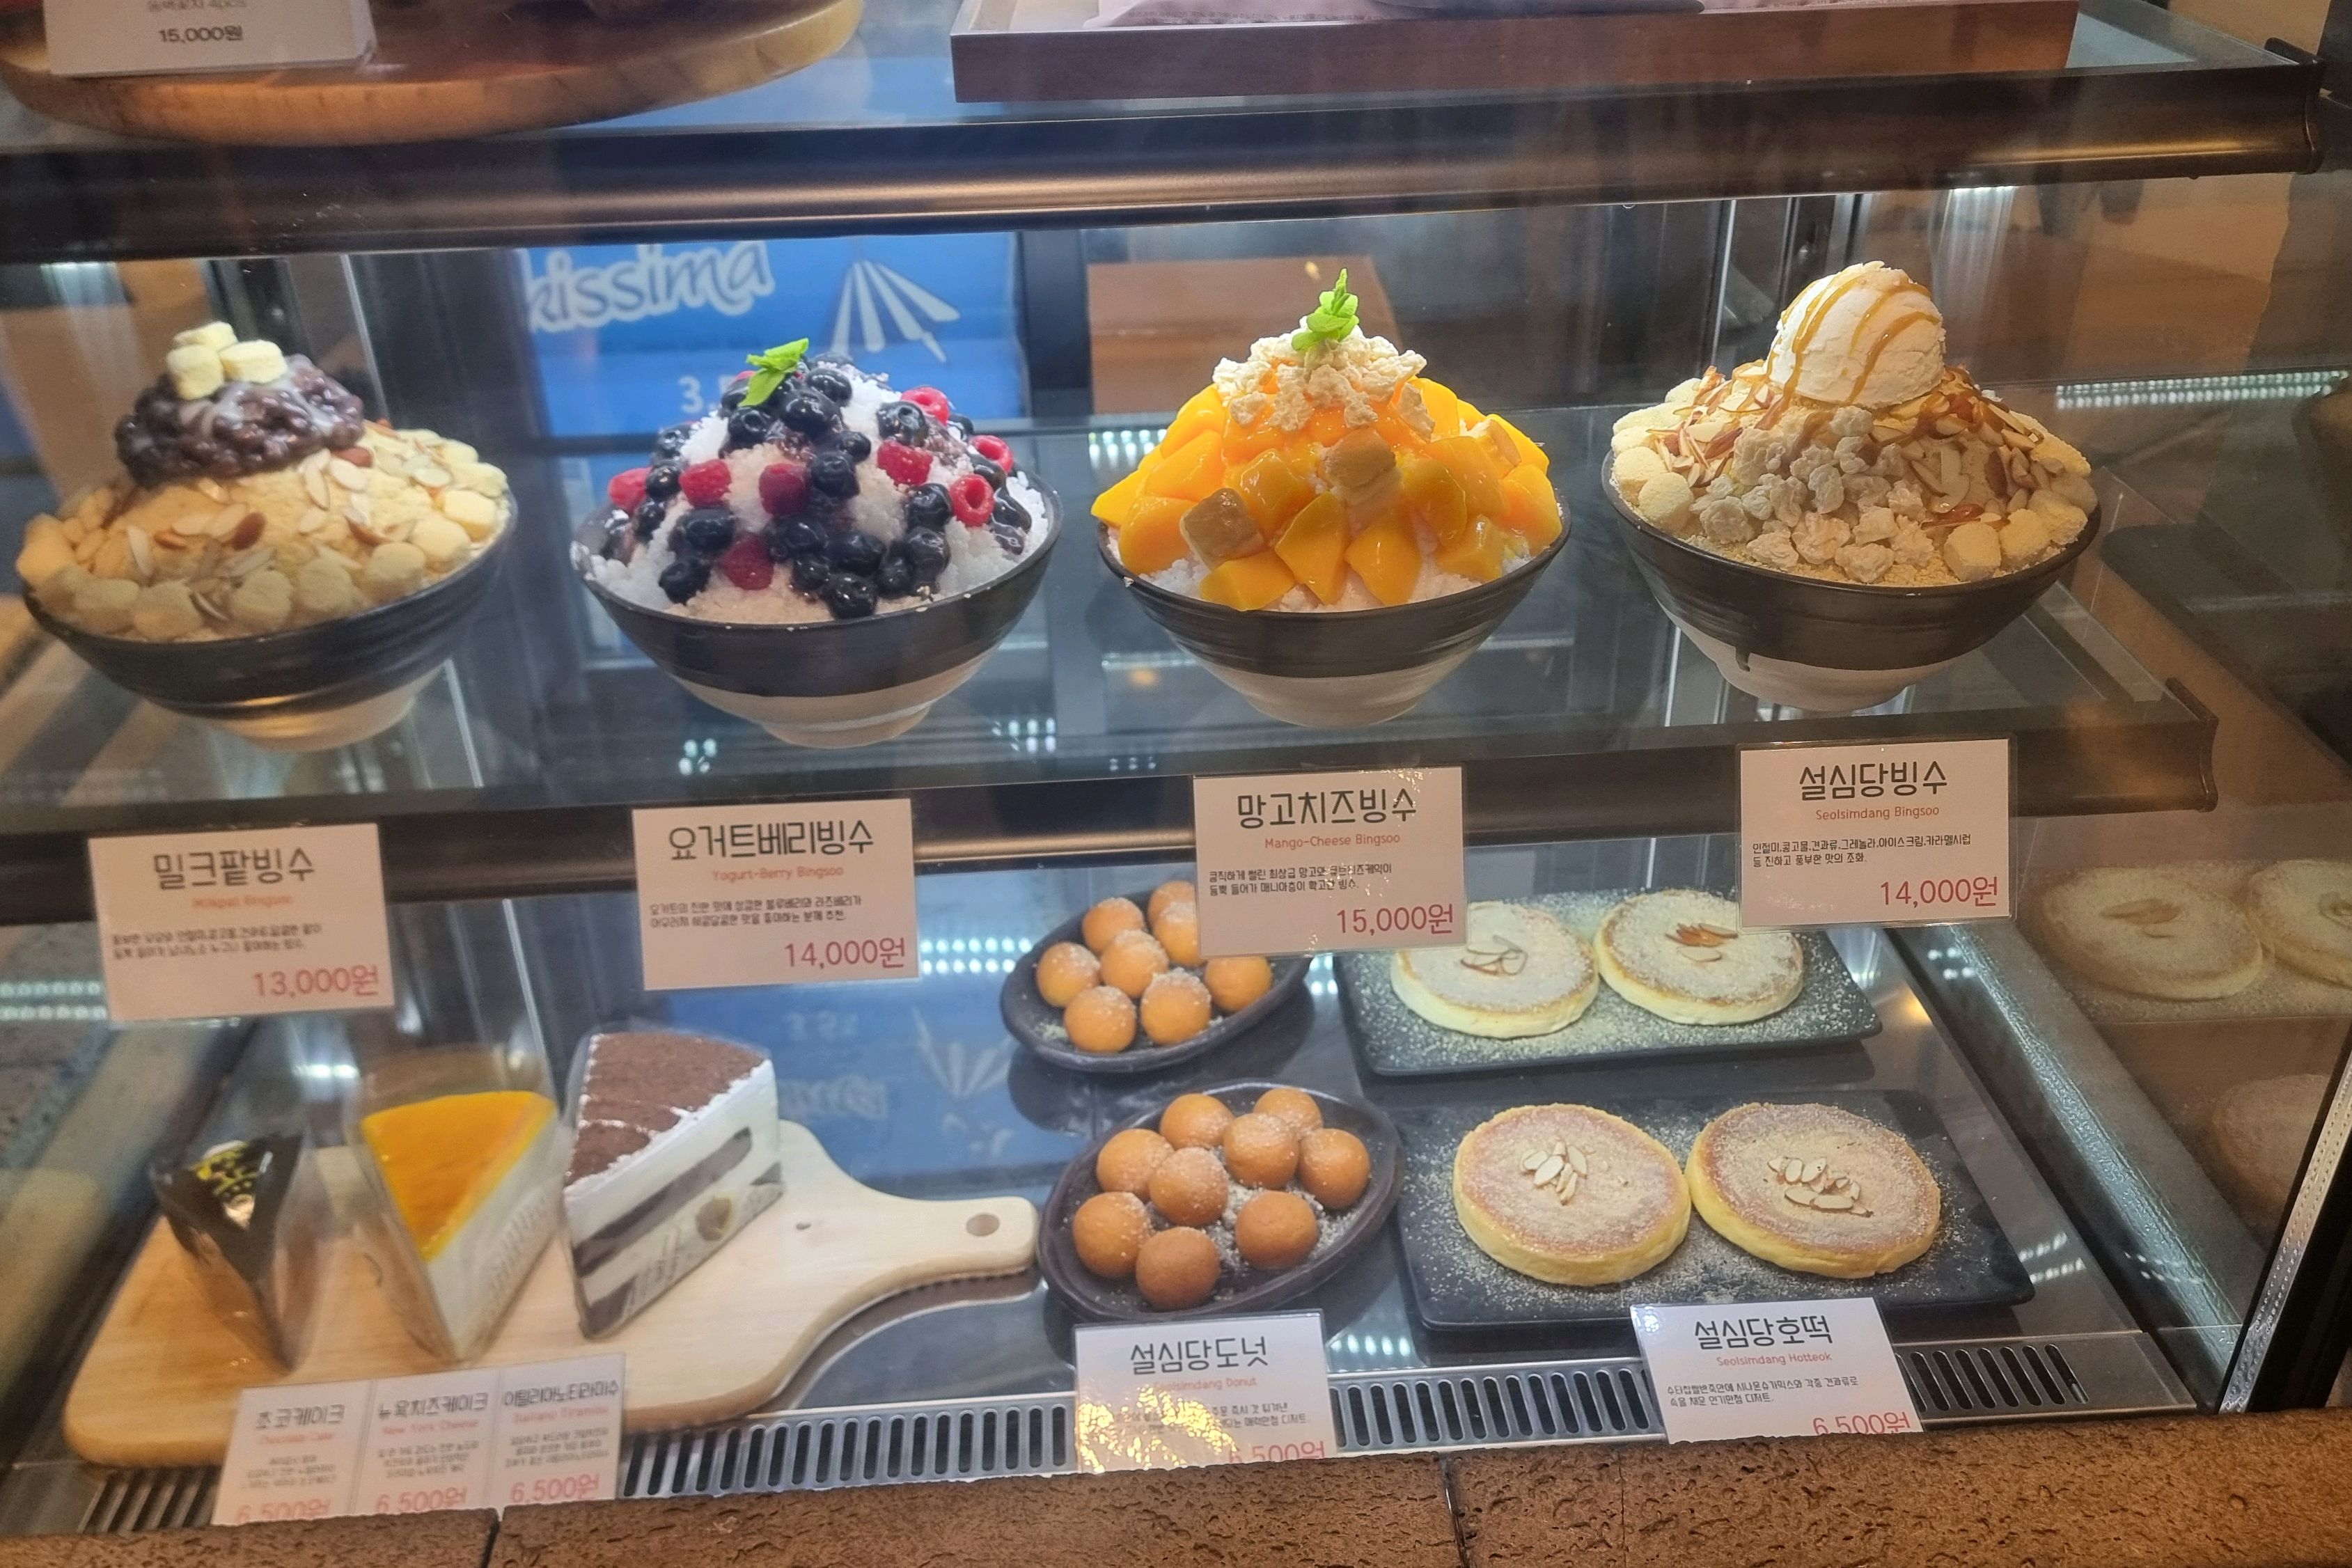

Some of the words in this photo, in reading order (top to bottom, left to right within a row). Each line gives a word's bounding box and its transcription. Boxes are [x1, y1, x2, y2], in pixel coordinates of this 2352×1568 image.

[159, 25, 244, 43] 15,000원
[1799, 760, 1947, 801] 설심당빙수
[1237, 787, 1417, 829] 망고치즈빙수
[1816, 808, 1890, 821] Seolsimdang
[1895, 806, 1940, 819] Bingsoo
[668, 820, 874, 861] 요거트베리빙수
[1265, 836, 1351, 850] Mango-Cheese
[1355, 833, 1401, 847] Bingsoo
[152, 847, 315, 891] 밀크팥빙수
[1753, 856, 1762, 868] 등
[1765, 855, 1791, 867] 진하고
[1795, 854, 1822, 865] 풍부한
[1825, 852, 1843, 864] 맛의
[712, 868, 792, 883] Yogurt-Berry
[797, 865, 844, 879] Bingsoo
[1209, 870, 1245, 882] 큼직하게
[1269, 868, 1296, 879] 최상급
[1299, 867, 1326, 878] 망고와
[1231, 883, 1257, 895] 들어가
[1880, 876, 1998, 909] 14,000원
[1336, 903, 1453, 936] 15,000원
[784, 936, 905, 969] 14,000원
[254, 964, 379, 998] 13,000원
[1694, 1315, 1833, 1350] 설심당호떡
[1131, 1335, 1269, 1375] 설심당도넛
[1716, 1354, 1786, 1366] Seolsimdang
[1789, 1351, 1833, 1363] Hotteok
[1824, 1376, 1858, 1387] 견과류로
[379, 1393, 489, 1420] 뉴욕치즈케이크
[1709, 1394, 1743, 1405] 인기만점
[255, 1404, 345, 1429] 초코케이크
[1812, 1411, 1911, 1434] 6500원
[1230, 1441, 1325, 1463] 6500원
[236, 1498, 331, 1523] 6500원
[375, 1486, 468, 1513] 6500원
